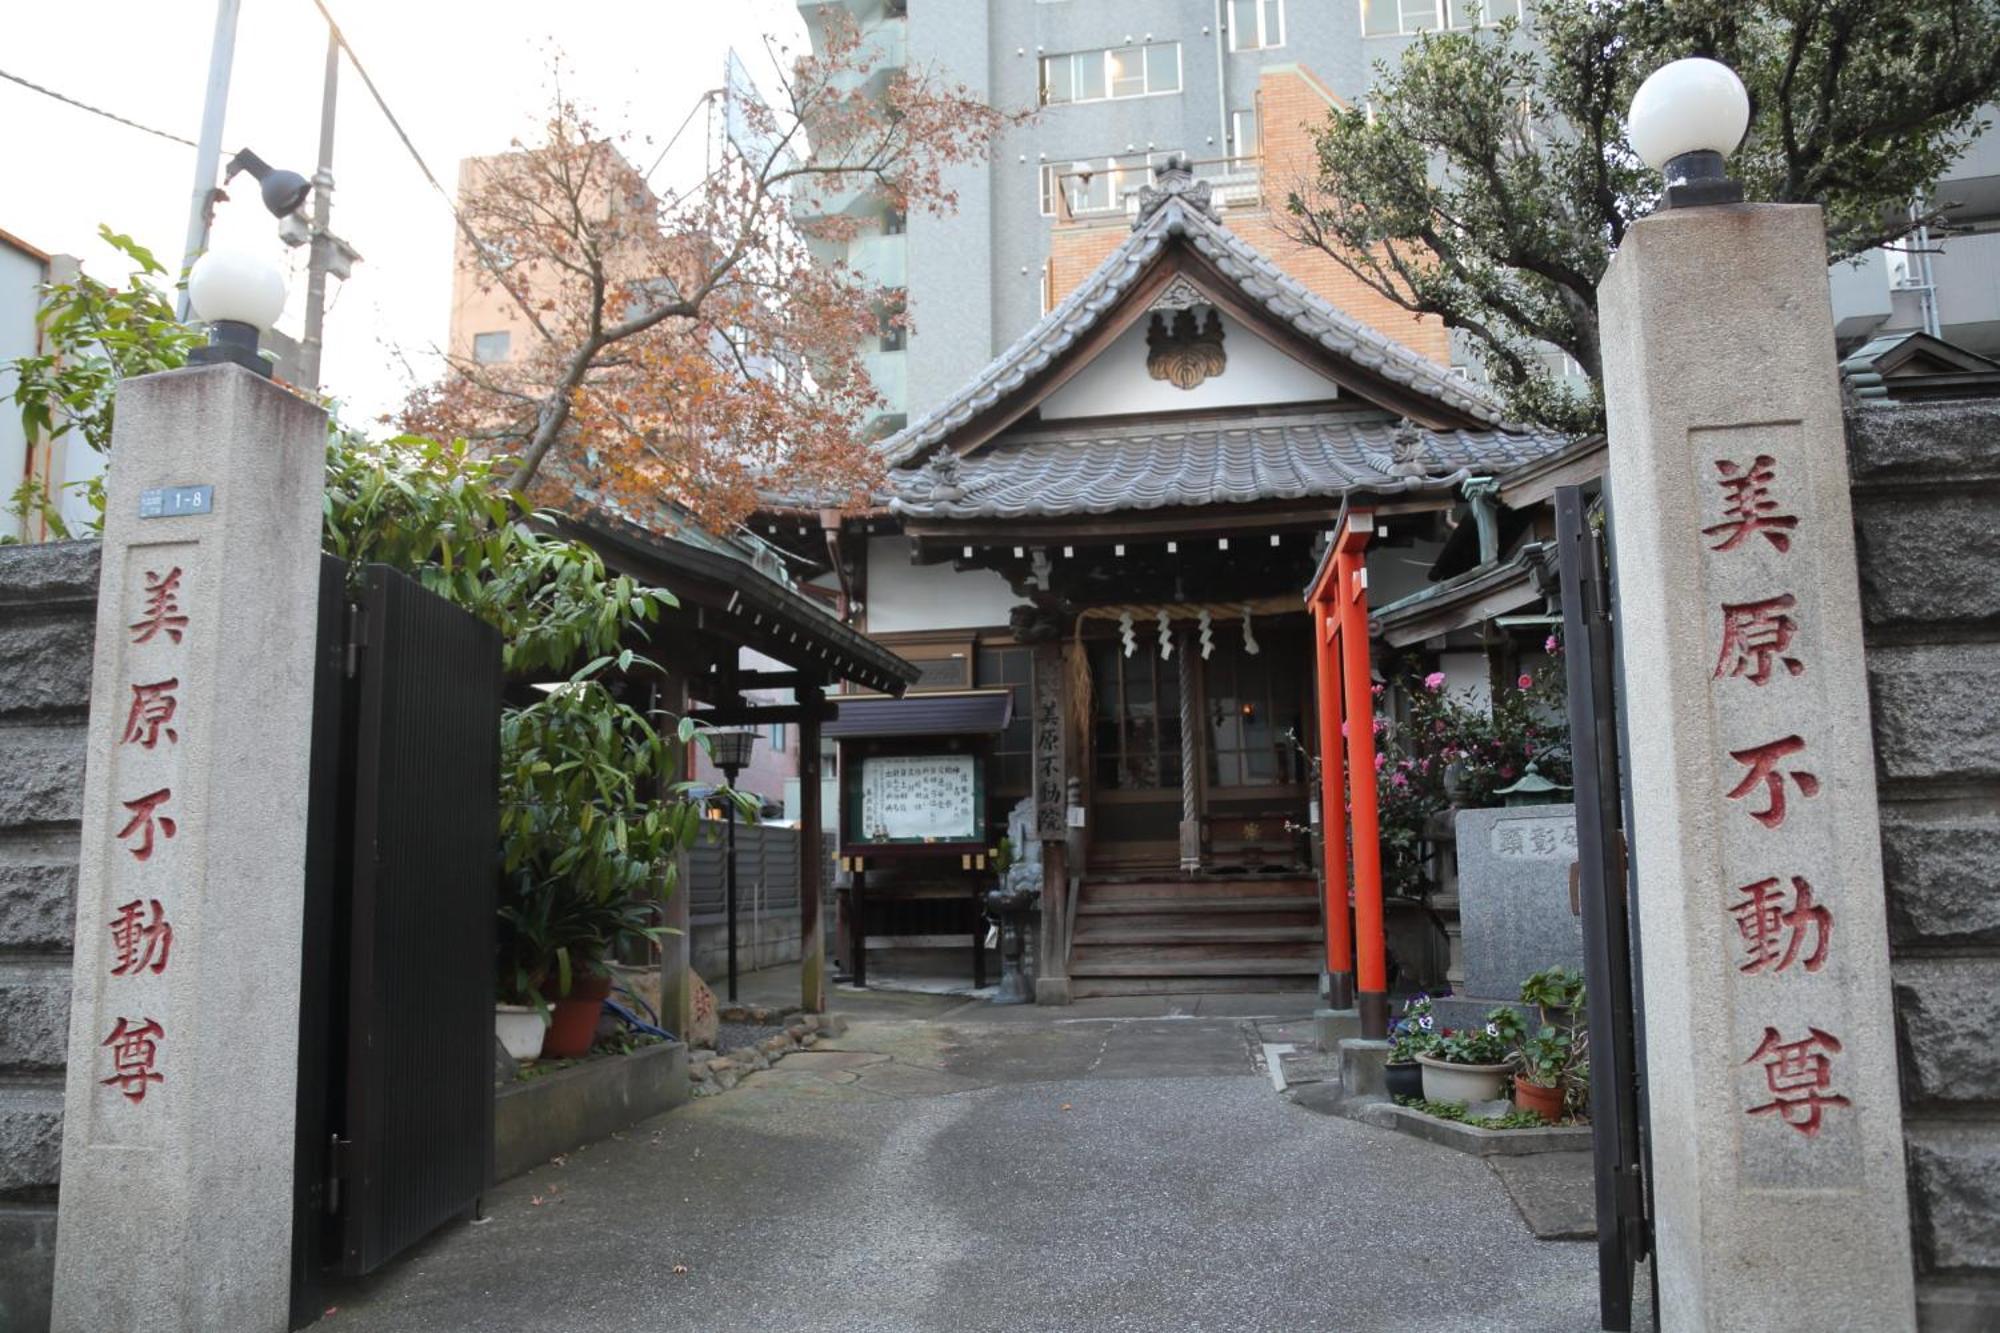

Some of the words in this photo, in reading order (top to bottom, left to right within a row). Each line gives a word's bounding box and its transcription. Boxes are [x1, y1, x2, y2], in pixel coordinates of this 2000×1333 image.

[175, 491, 202, 509] 1-8
[100, 566, 190, 1105] 美原不動尊
[1702, 454, 1852, 1138] 美原不動尊
